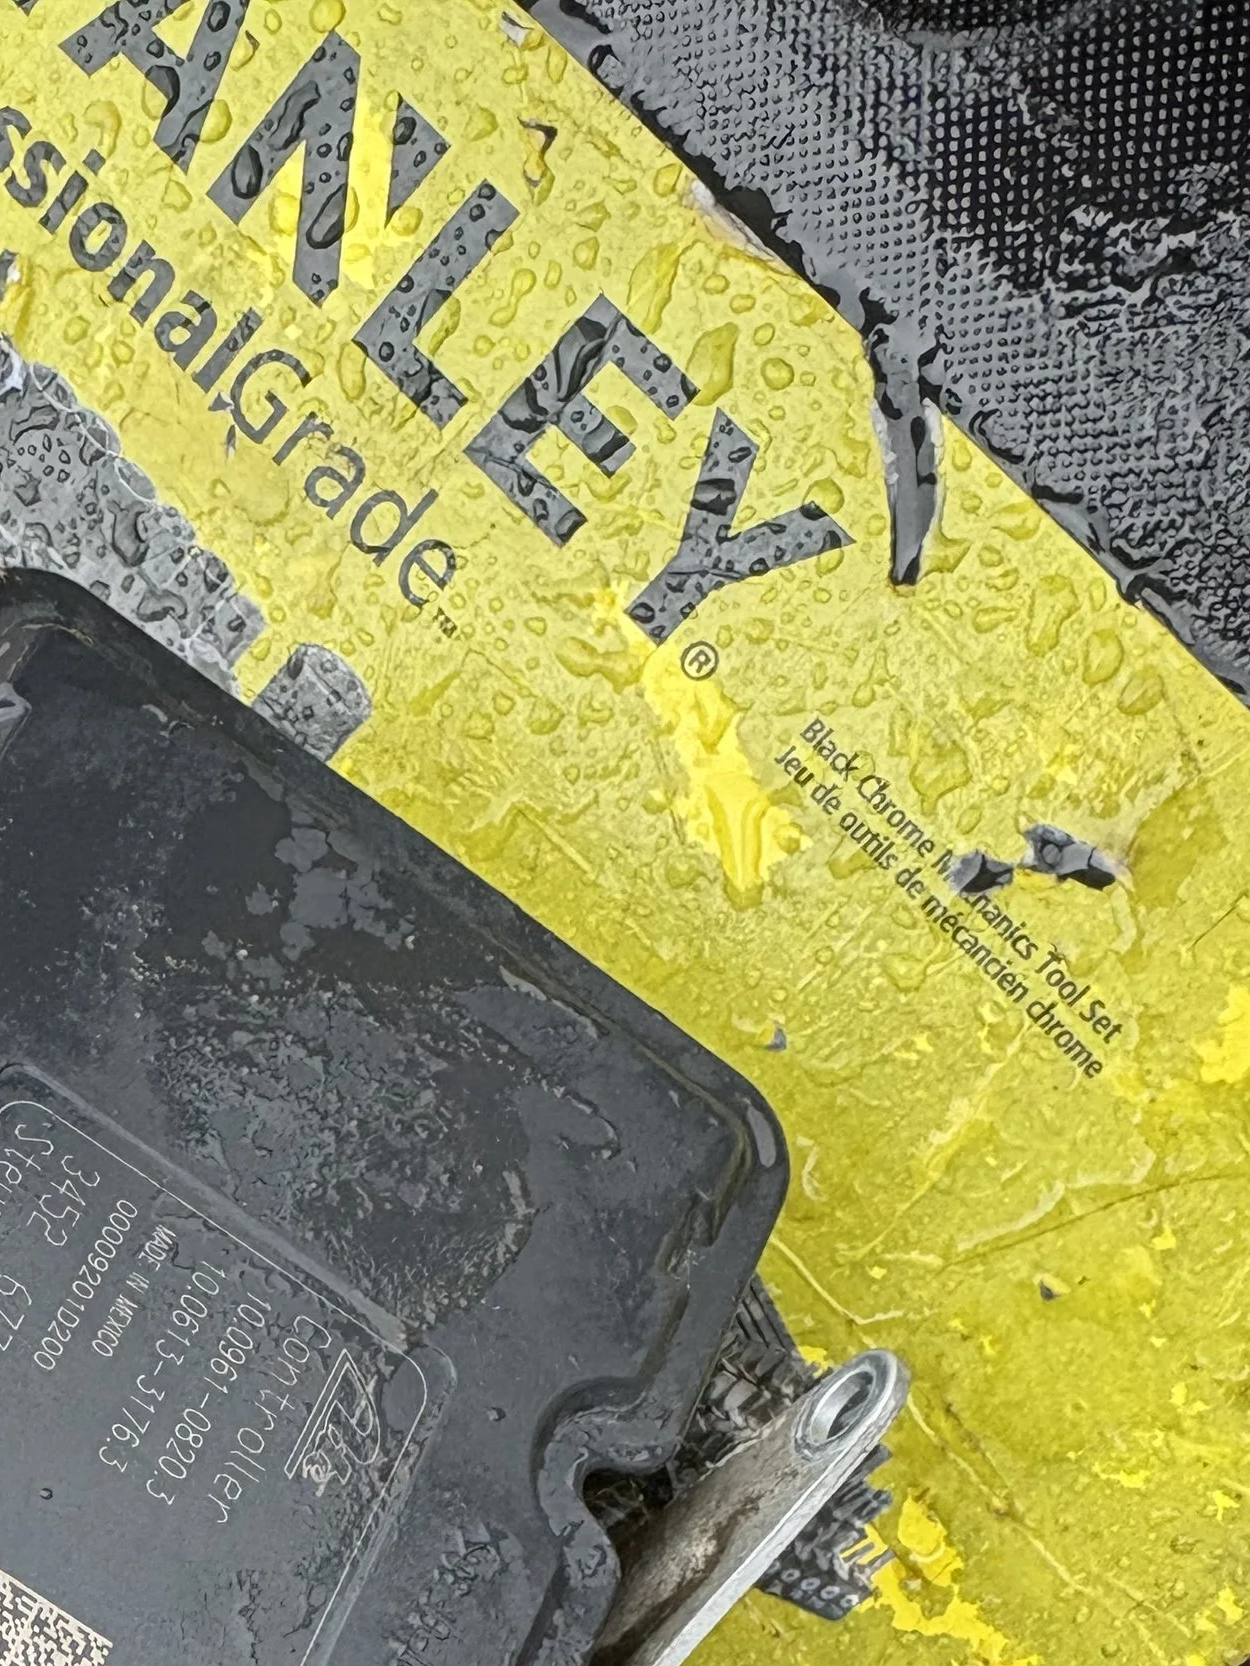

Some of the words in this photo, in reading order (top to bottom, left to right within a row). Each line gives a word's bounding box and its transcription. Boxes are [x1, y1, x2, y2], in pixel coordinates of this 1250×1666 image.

[775, 745, 815, 787] Jeu
[811, 783, 842, 816] de
[839, 810, 899, 871] outils
[895, 865, 927, 900] de
[1026, 994, 1104, 1080] chrome
[799, 717, 860, 783] Black
[856, 774, 935, 857] Chrome
[932, 849, 1040, 959] Mhanics
[1036, 948, 1090, 1008] Tool
[1080, 999, 1124, 1045] Set
[26, 1155, 100, 1246] 3452
[34, 1199, 138, 1371] 00009201D200
[125, 1272, 150, 1294] IN
[138, 1224, 177, 1272] MADE
[92, 1294, 139, 1357] MEXICO
[99, 1260, 227, 1473] 10.0613-3176.3
[146, 1292, 271, 1505] 10.0961-0820.3
[208, 1315, 332, 1523] Controller
